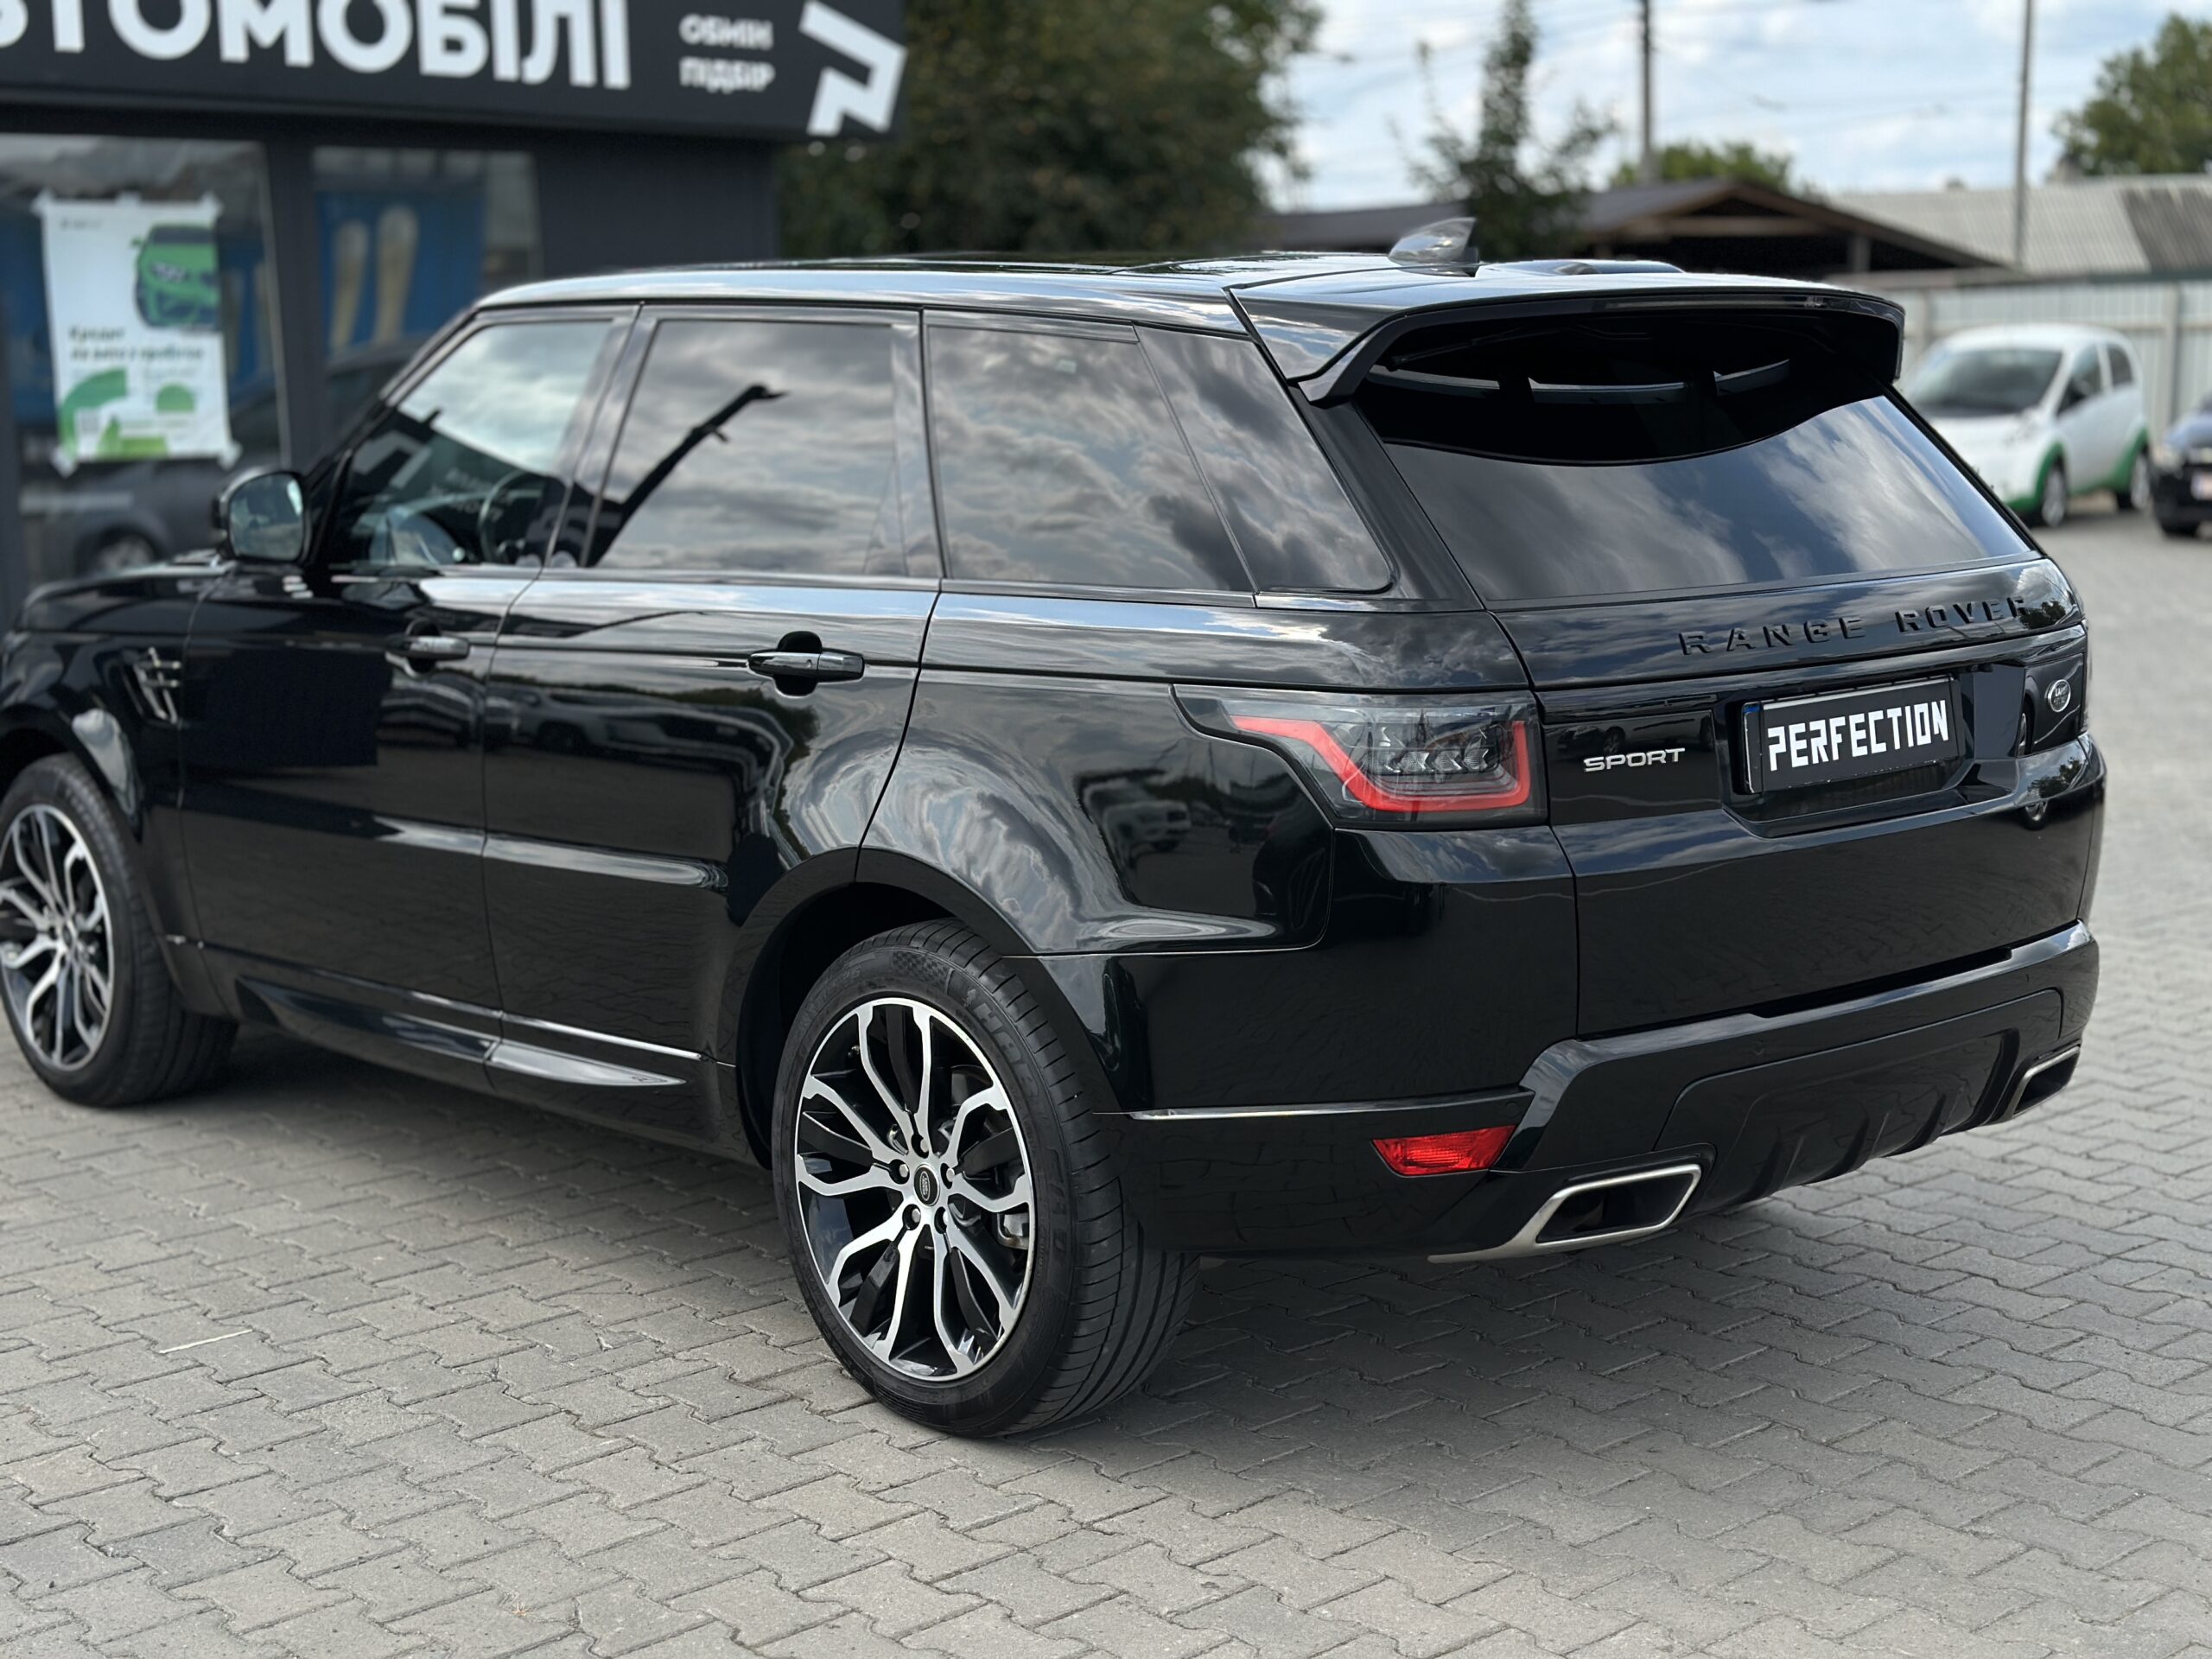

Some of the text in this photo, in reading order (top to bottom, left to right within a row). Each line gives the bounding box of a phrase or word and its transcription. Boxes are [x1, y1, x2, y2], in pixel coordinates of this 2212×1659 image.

[0, 0, 631, 89] ОМОБІЛІ
[1677, 595, 2029, 657] RANGE ROVER
[1583, 747, 1686, 772] SPORT
[1767, 699, 1949, 772] PERFECTION
